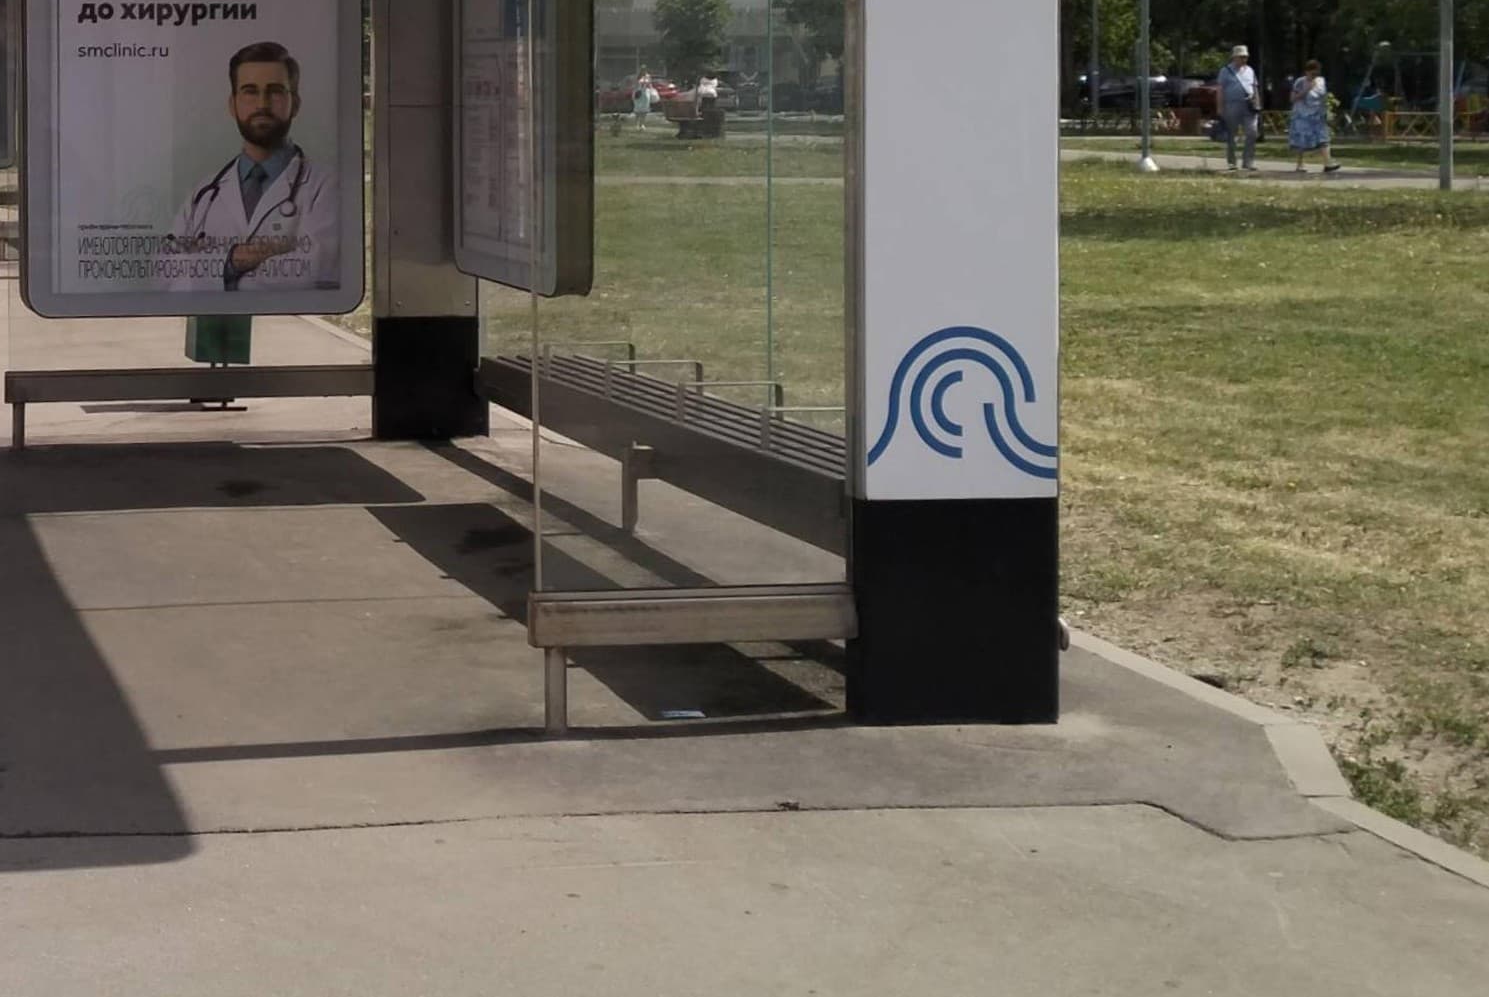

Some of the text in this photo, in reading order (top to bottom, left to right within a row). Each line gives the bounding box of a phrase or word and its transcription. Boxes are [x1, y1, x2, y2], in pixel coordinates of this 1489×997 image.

[78, 2, 257, 26] до хирургии
[78, 43, 169, 58] smclinic.ru
[79, 235, 128, 255] ИМЕЮТСЯ
